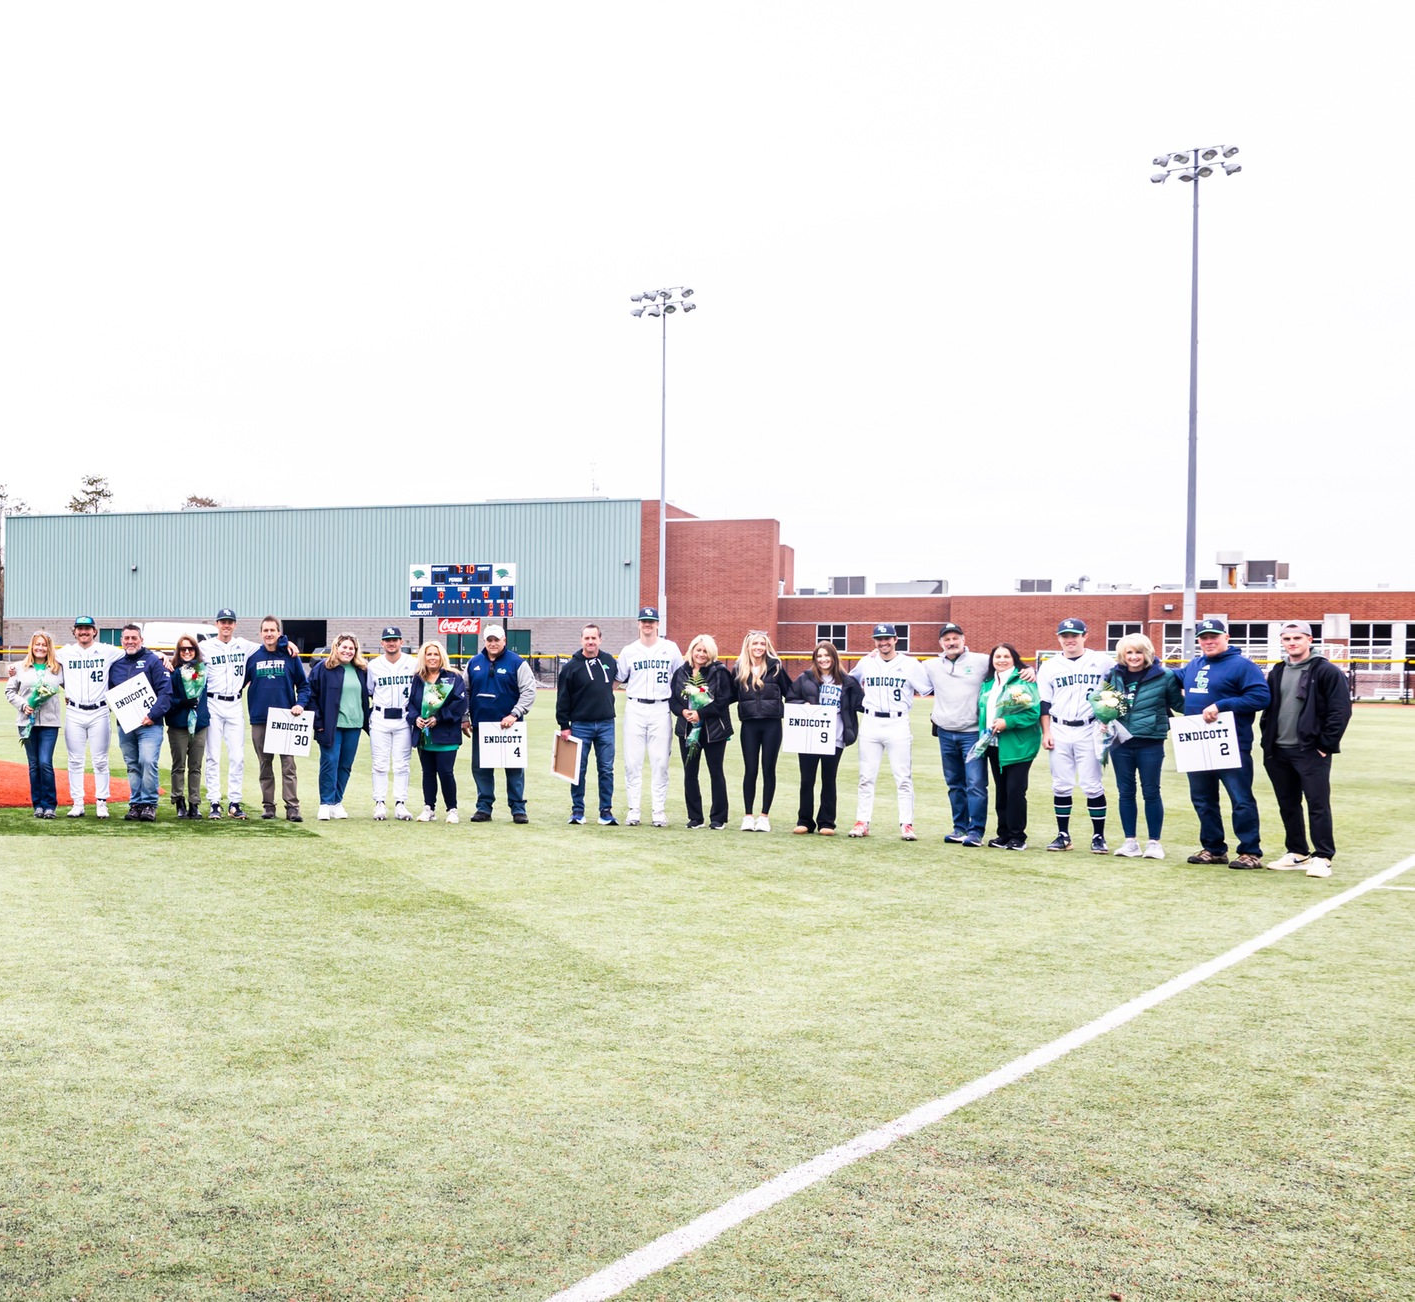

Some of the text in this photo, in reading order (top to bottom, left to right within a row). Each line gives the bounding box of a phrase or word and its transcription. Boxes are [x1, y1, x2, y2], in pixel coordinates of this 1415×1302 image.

[69, 659, 104, 669] ENDICOTT
[211, 653, 245, 665] ENDICOTT
[234, 665, 244, 676] 30
[634, 660, 670, 670] ENDICOTT
[90, 670, 104, 682] 42
[378, 676, 414, 686] ENDICOTT
[656, 672, 668, 684] 25
[1056, 674, 1101, 688] ENDICOTT
[866, 677, 906, 688] ENDICOTT
[115, 686, 148, 710] ENDICOTT
[402, 687, 409, 698] 4
[894, 690, 901, 702] 9
[143, 696, 155, 710] 42
[272, 722, 308, 732] ENDICOTT
[789, 718, 830, 728] ENDICOTT
[294, 735, 308, 746] 30
[484, 736, 522, 744] ENDICOTT
[820, 732, 828, 743] 9
[1179, 729, 1228, 742] ENDICOTT
[514, 747, 520, 758] 4
[1220, 742, 1230, 756] 2
